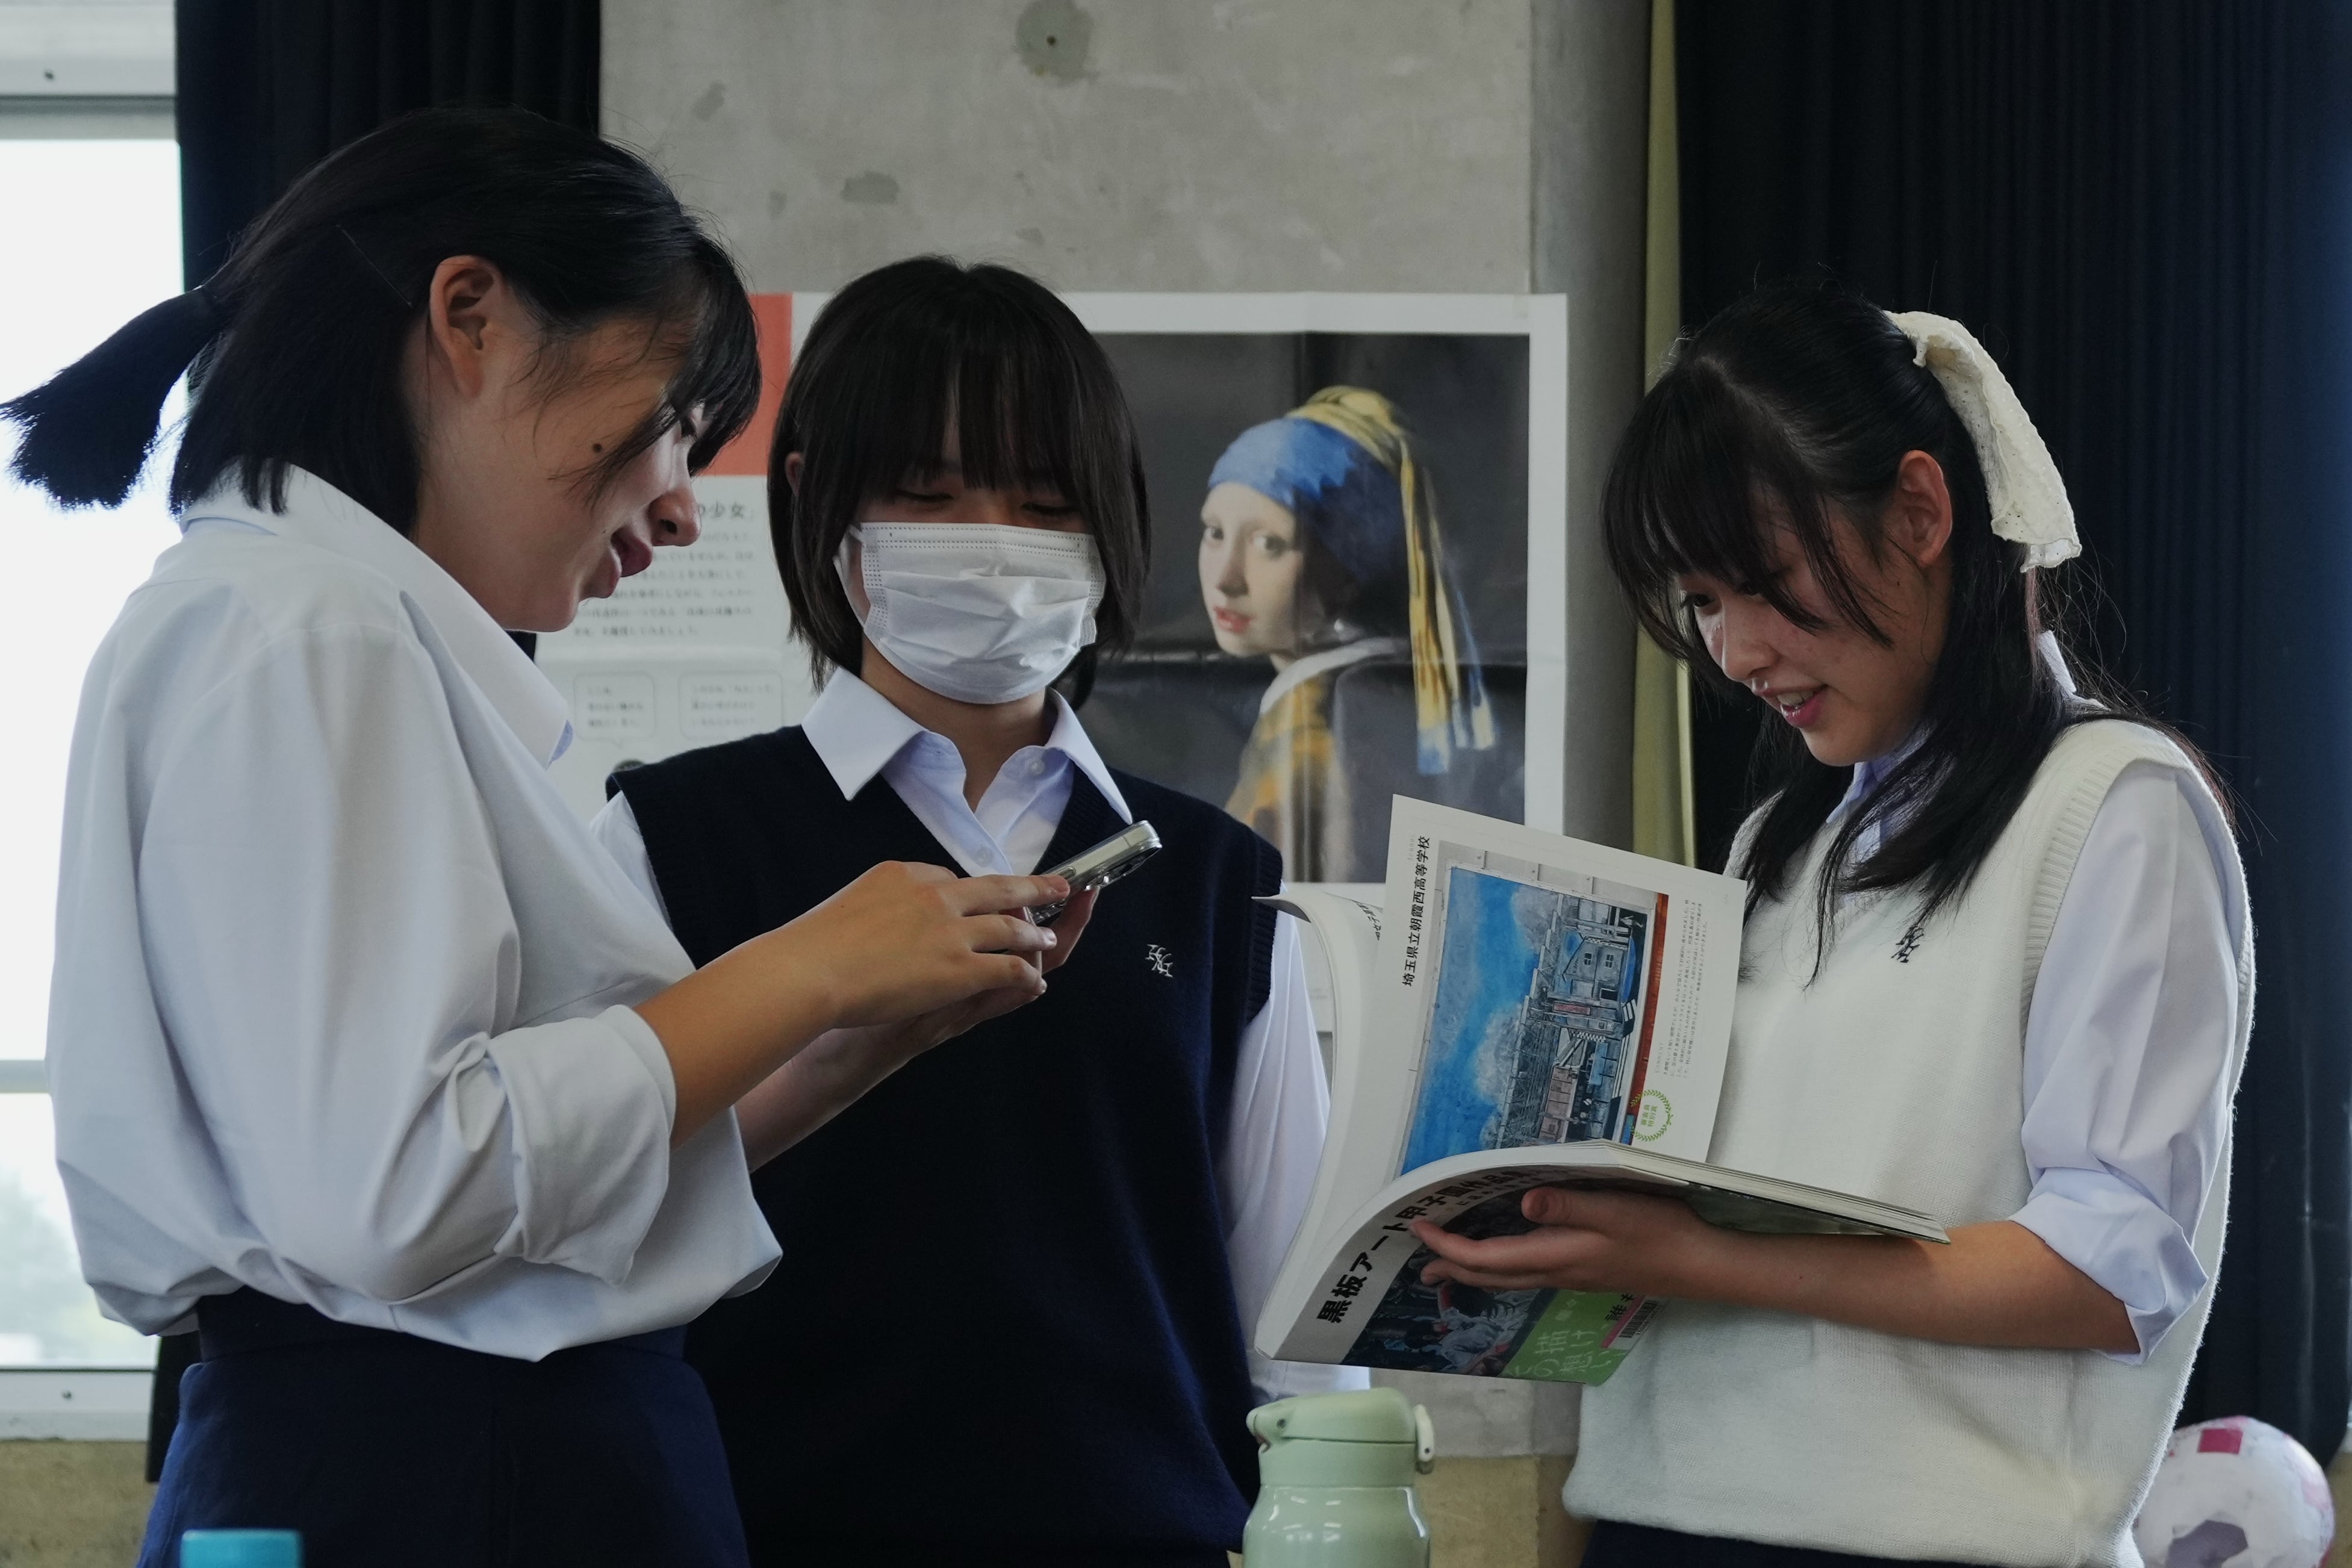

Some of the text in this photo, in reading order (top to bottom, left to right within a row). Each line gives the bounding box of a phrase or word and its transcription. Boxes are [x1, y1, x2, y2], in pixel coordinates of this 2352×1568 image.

[1402, 836, 1430, 986] 埼玉県立朝霞西高等学校
